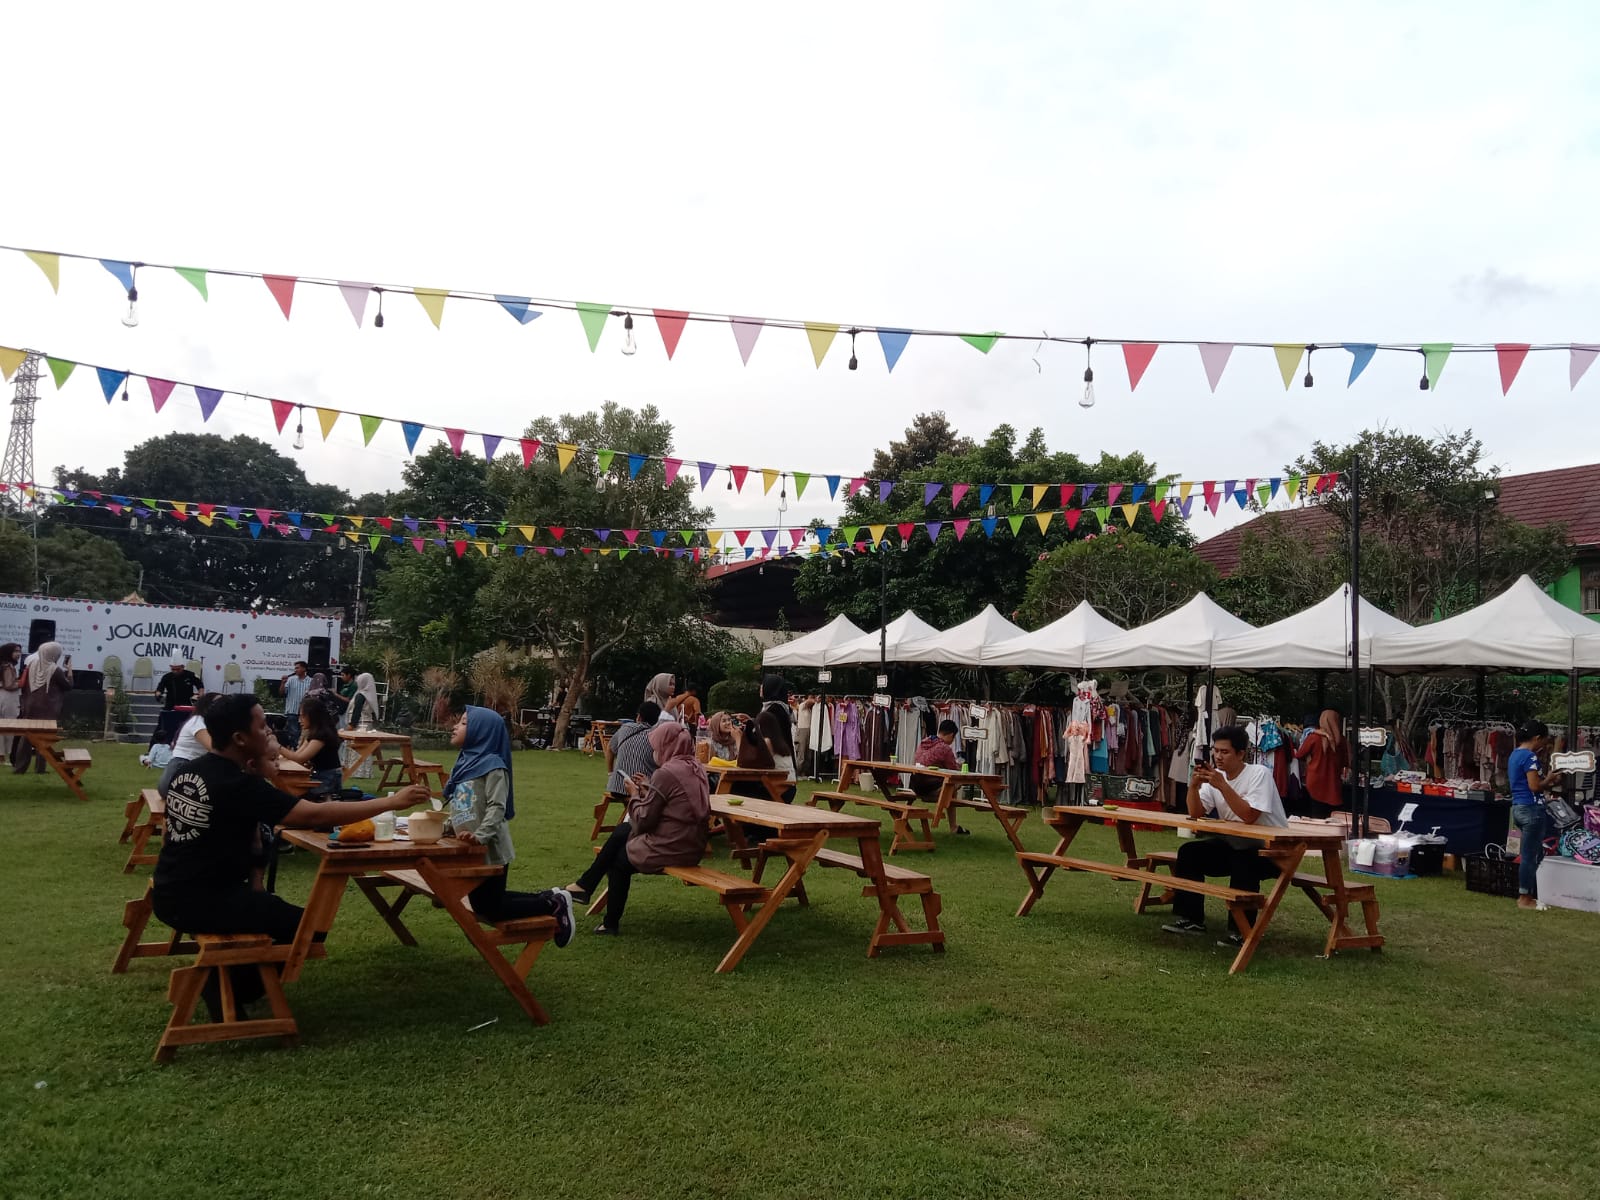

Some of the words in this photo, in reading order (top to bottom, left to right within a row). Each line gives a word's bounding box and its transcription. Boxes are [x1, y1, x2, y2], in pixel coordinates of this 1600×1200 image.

[106, 622, 224, 648] JOGJAVAGANZA
[255, 635, 283, 644] SATURDAY
[171, 773, 210, 803] WORLDWIDE
[166, 795, 211, 822] DICKIES
